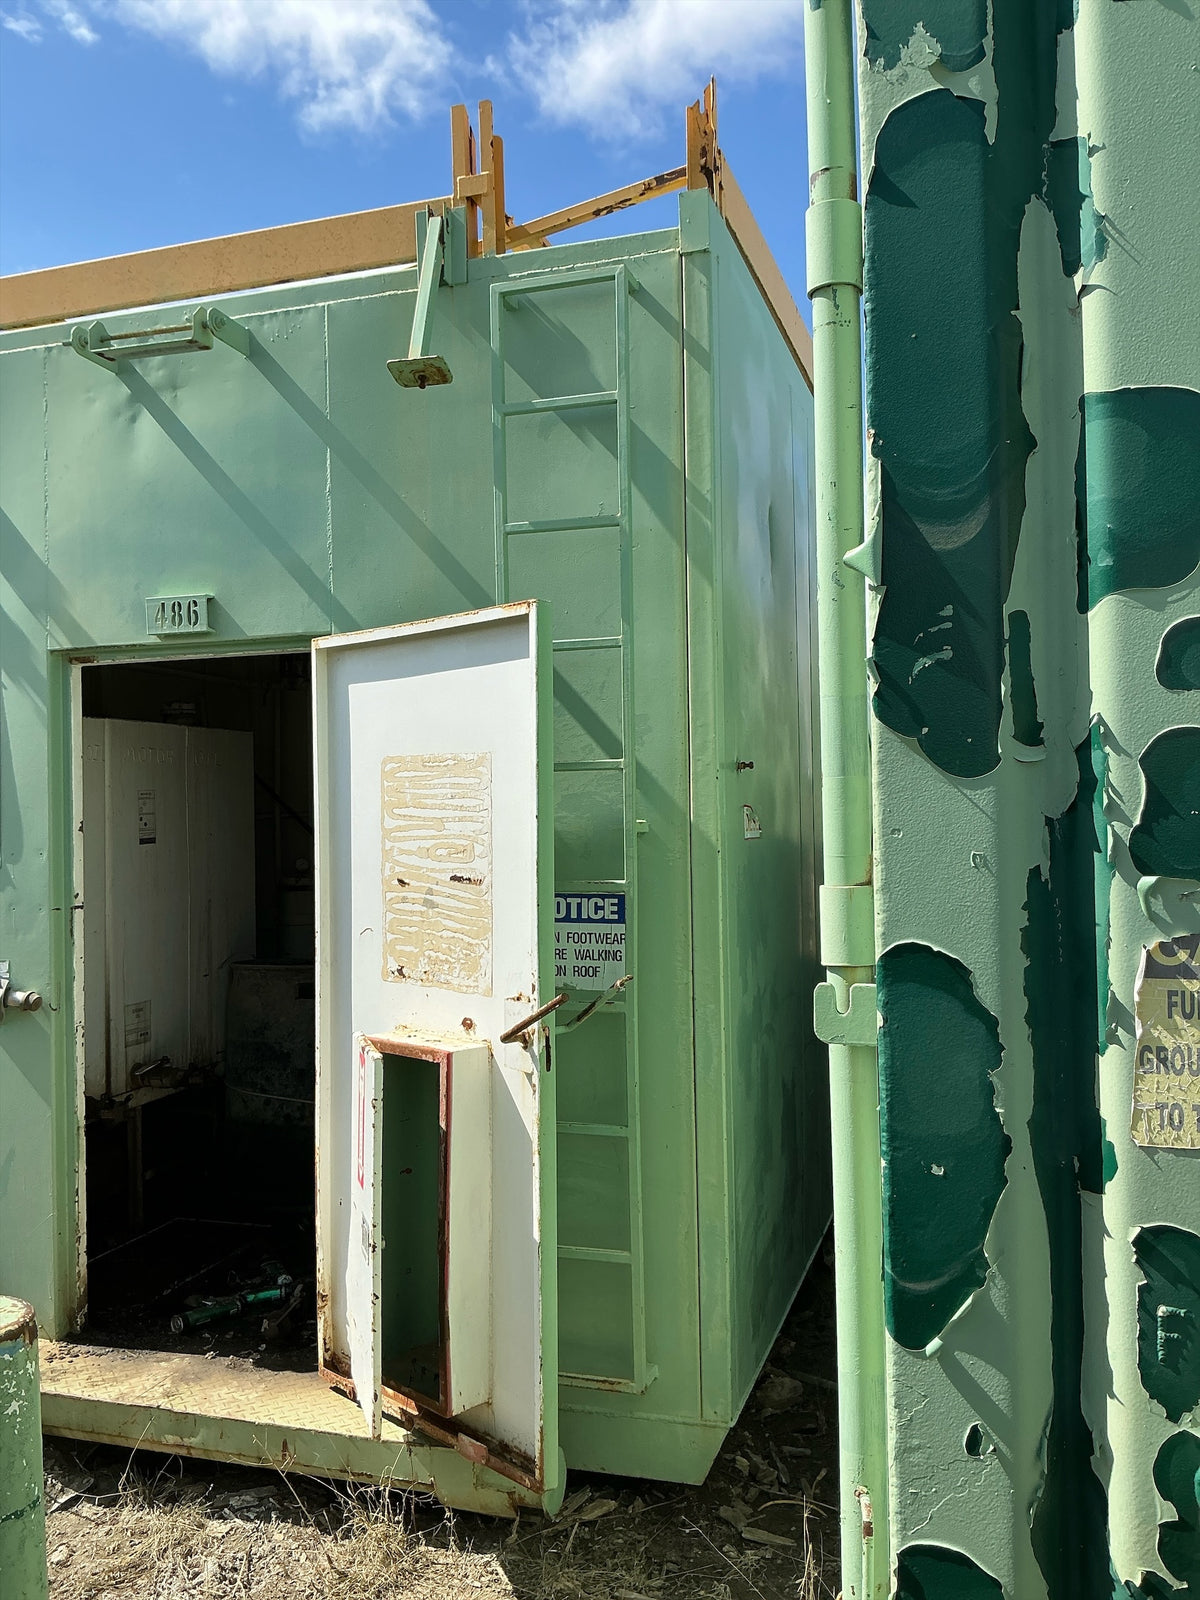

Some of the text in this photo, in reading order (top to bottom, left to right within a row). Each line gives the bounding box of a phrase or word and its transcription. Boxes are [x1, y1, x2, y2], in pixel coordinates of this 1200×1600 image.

[154, 599, 200, 628] 486
[574, 949, 623, 961] WALKING
[573, 965, 601, 977] ROOF
[1167, 989, 1200, 1020] FU
[1154, 1101, 1185, 1133] TO
